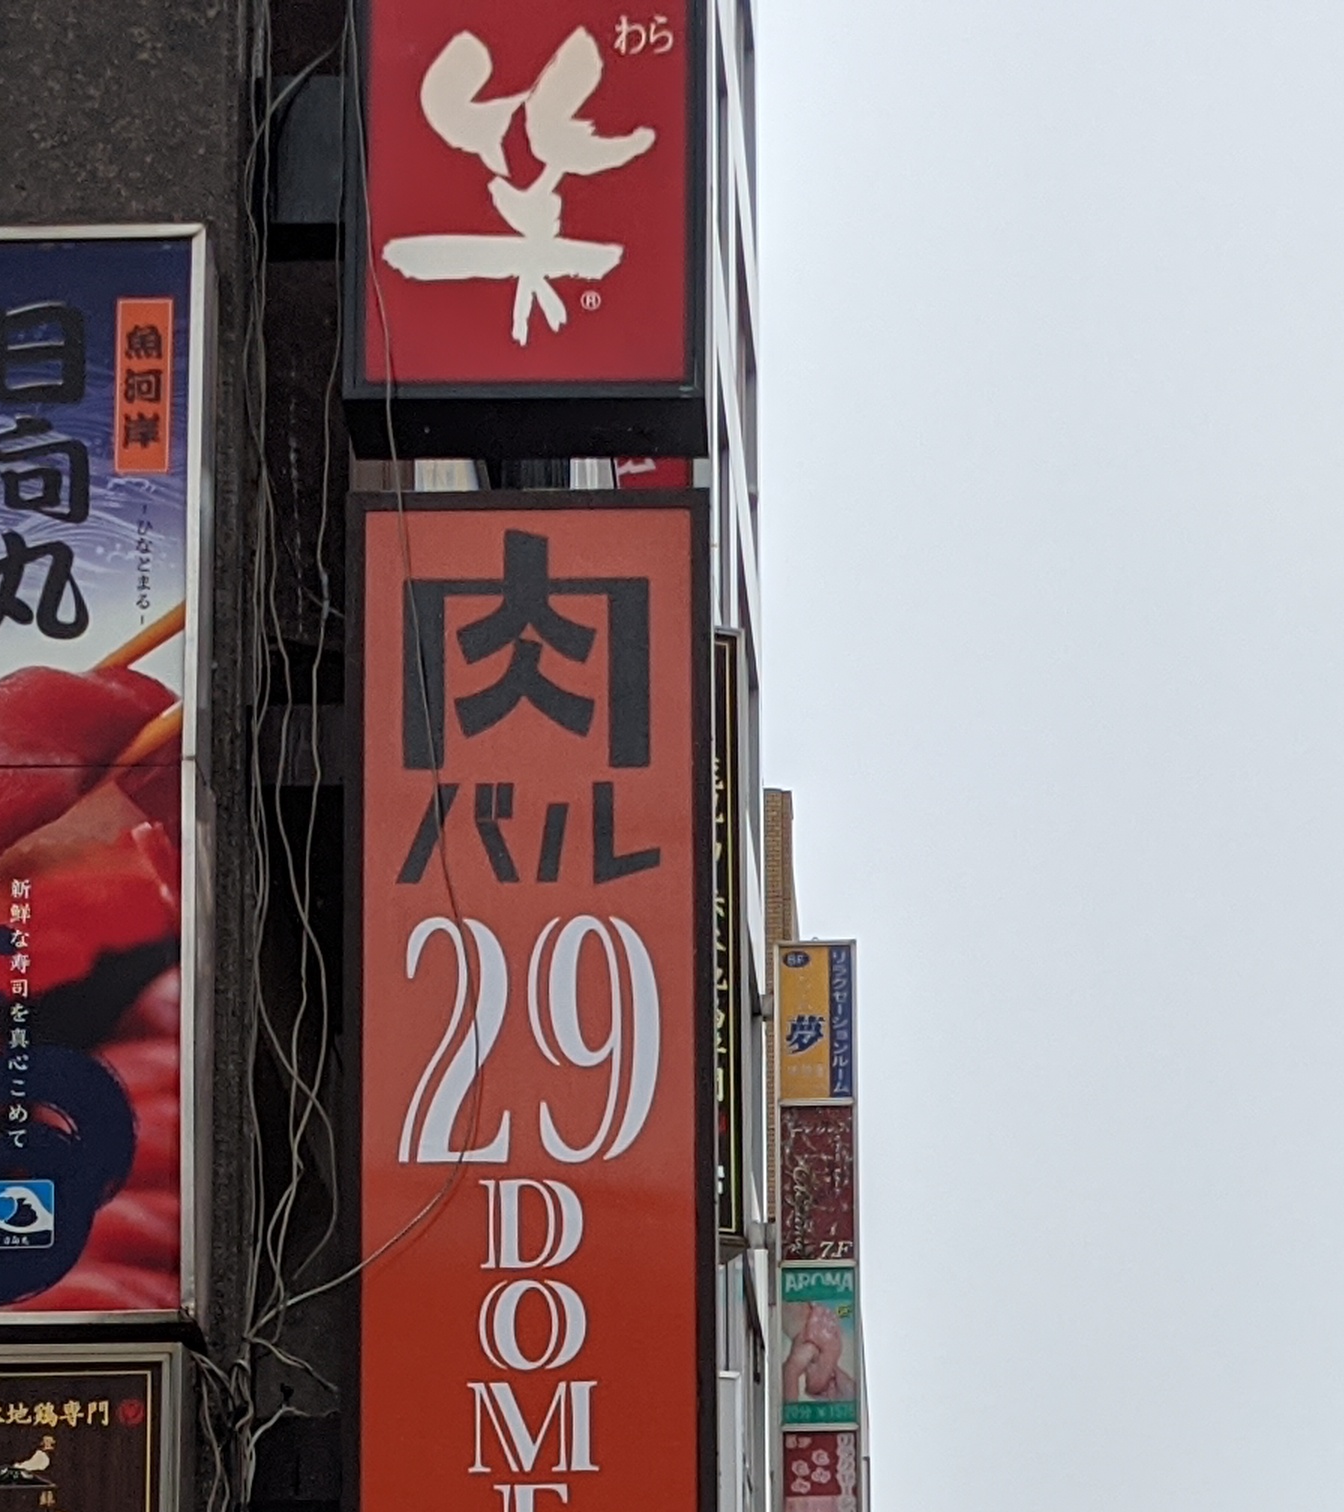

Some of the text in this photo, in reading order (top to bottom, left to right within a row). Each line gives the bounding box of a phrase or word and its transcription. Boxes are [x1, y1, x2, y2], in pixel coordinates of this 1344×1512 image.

[614, 15, 674, 54] わら
[123, 324, 164, 451] 魚河岸
[402, 529, 650, 769] 肉
[396, 781, 660, 885] バル
[9, 878, 32, 1148] 新鮮な寿司を真心こめて
[399, 915, 659, 1164] 29
[830, 951, 850, 1094] リラクゼーションルーム
[785, 1272, 853, 1293] AROMA
